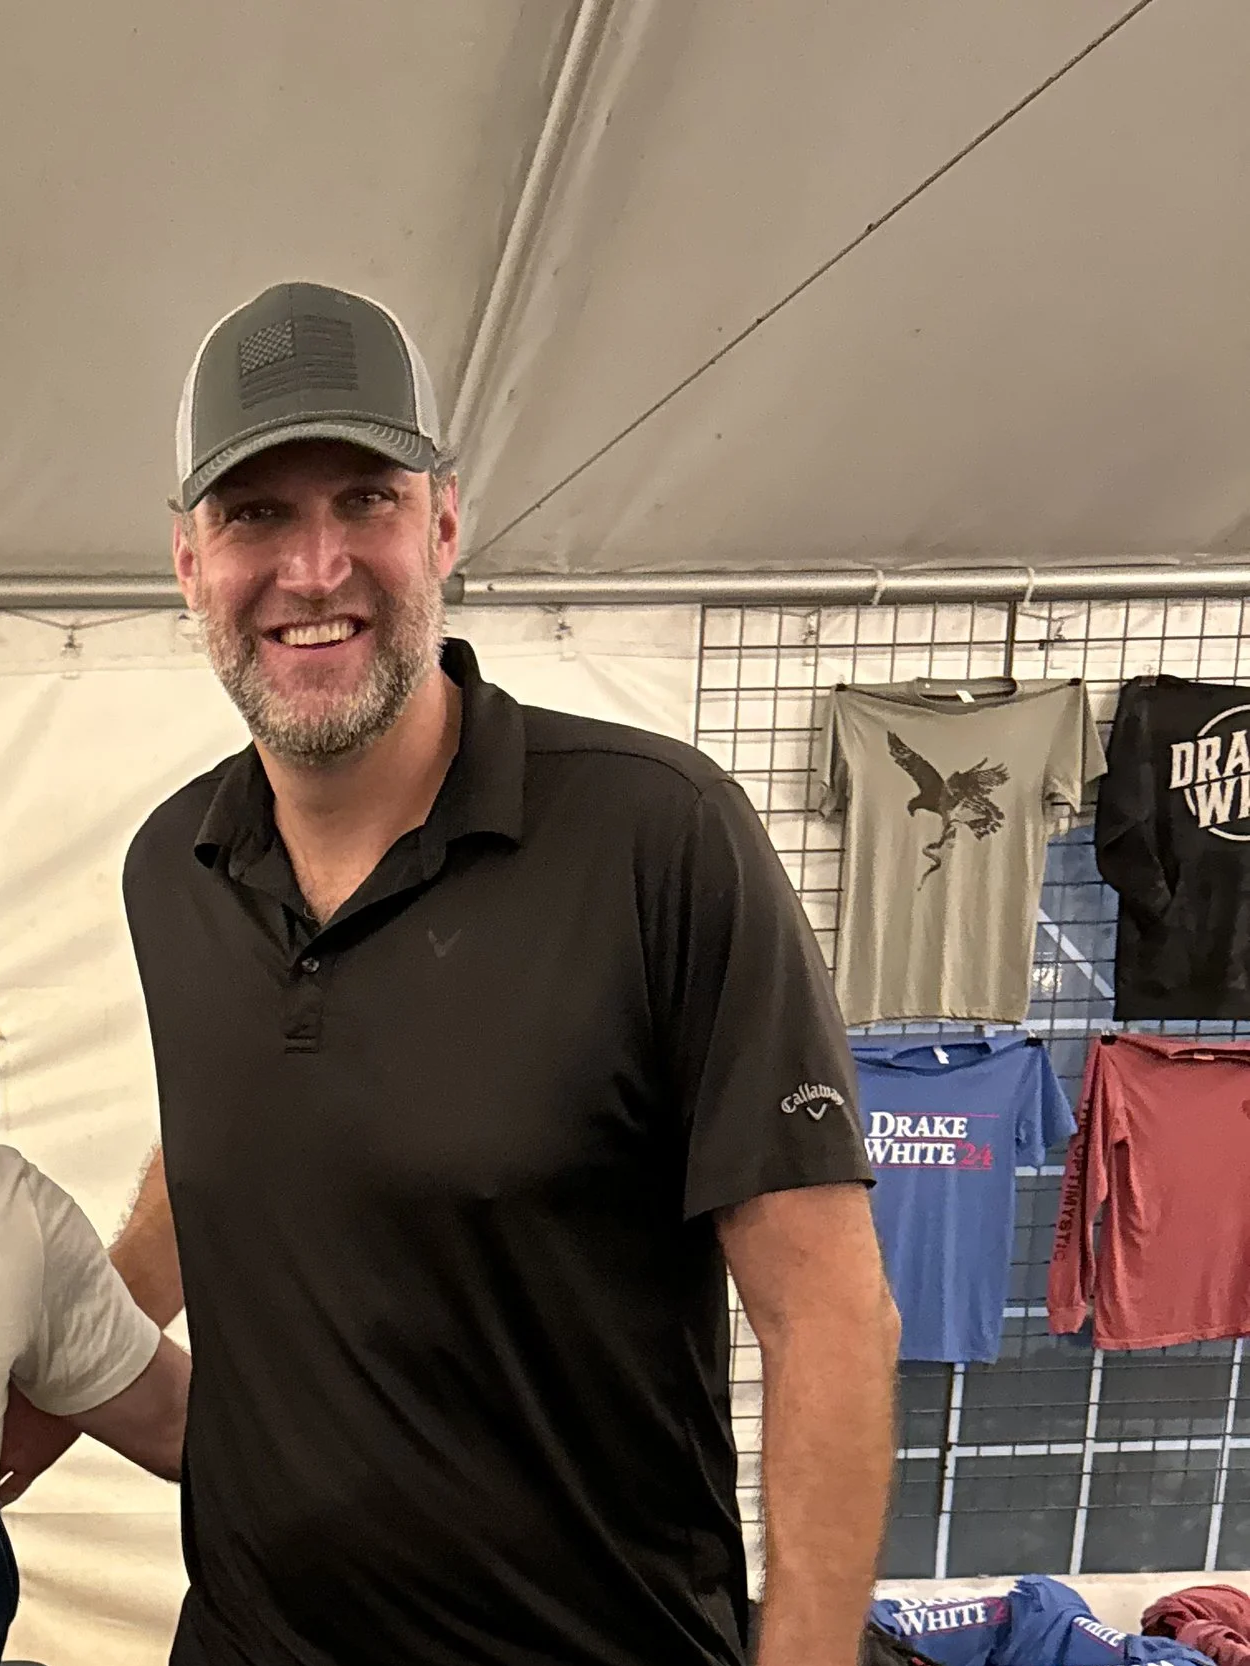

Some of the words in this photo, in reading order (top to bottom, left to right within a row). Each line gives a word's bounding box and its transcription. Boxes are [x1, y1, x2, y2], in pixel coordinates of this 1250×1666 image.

[1169, 729, 1250, 789] DRA
[781, 1082, 845, 1113] Callaway
[868, 1111, 968, 1139] DRAKE
[863, 1138, 957, 1165] WHITE
